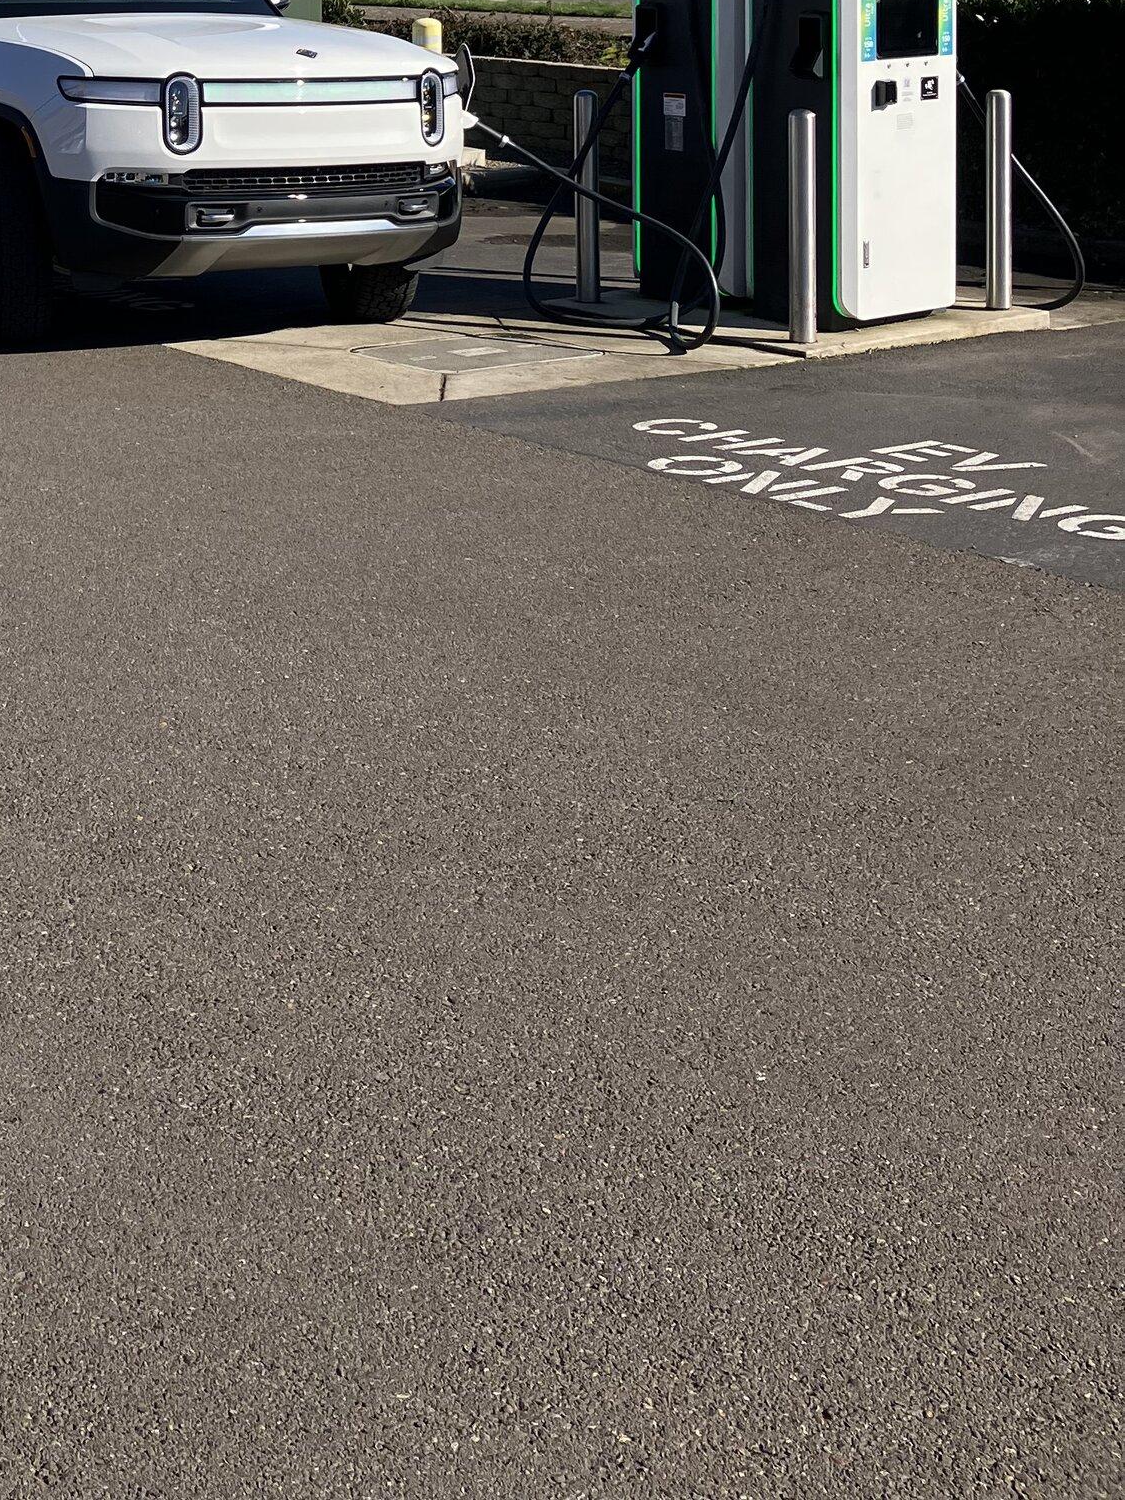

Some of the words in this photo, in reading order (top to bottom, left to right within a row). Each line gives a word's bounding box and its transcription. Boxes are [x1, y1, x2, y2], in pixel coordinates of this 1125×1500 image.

[632, 418, 1125, 541] CHARGING
[647, 455, 946, 519] ONLY
[870, 440, 1049, 472] EV
